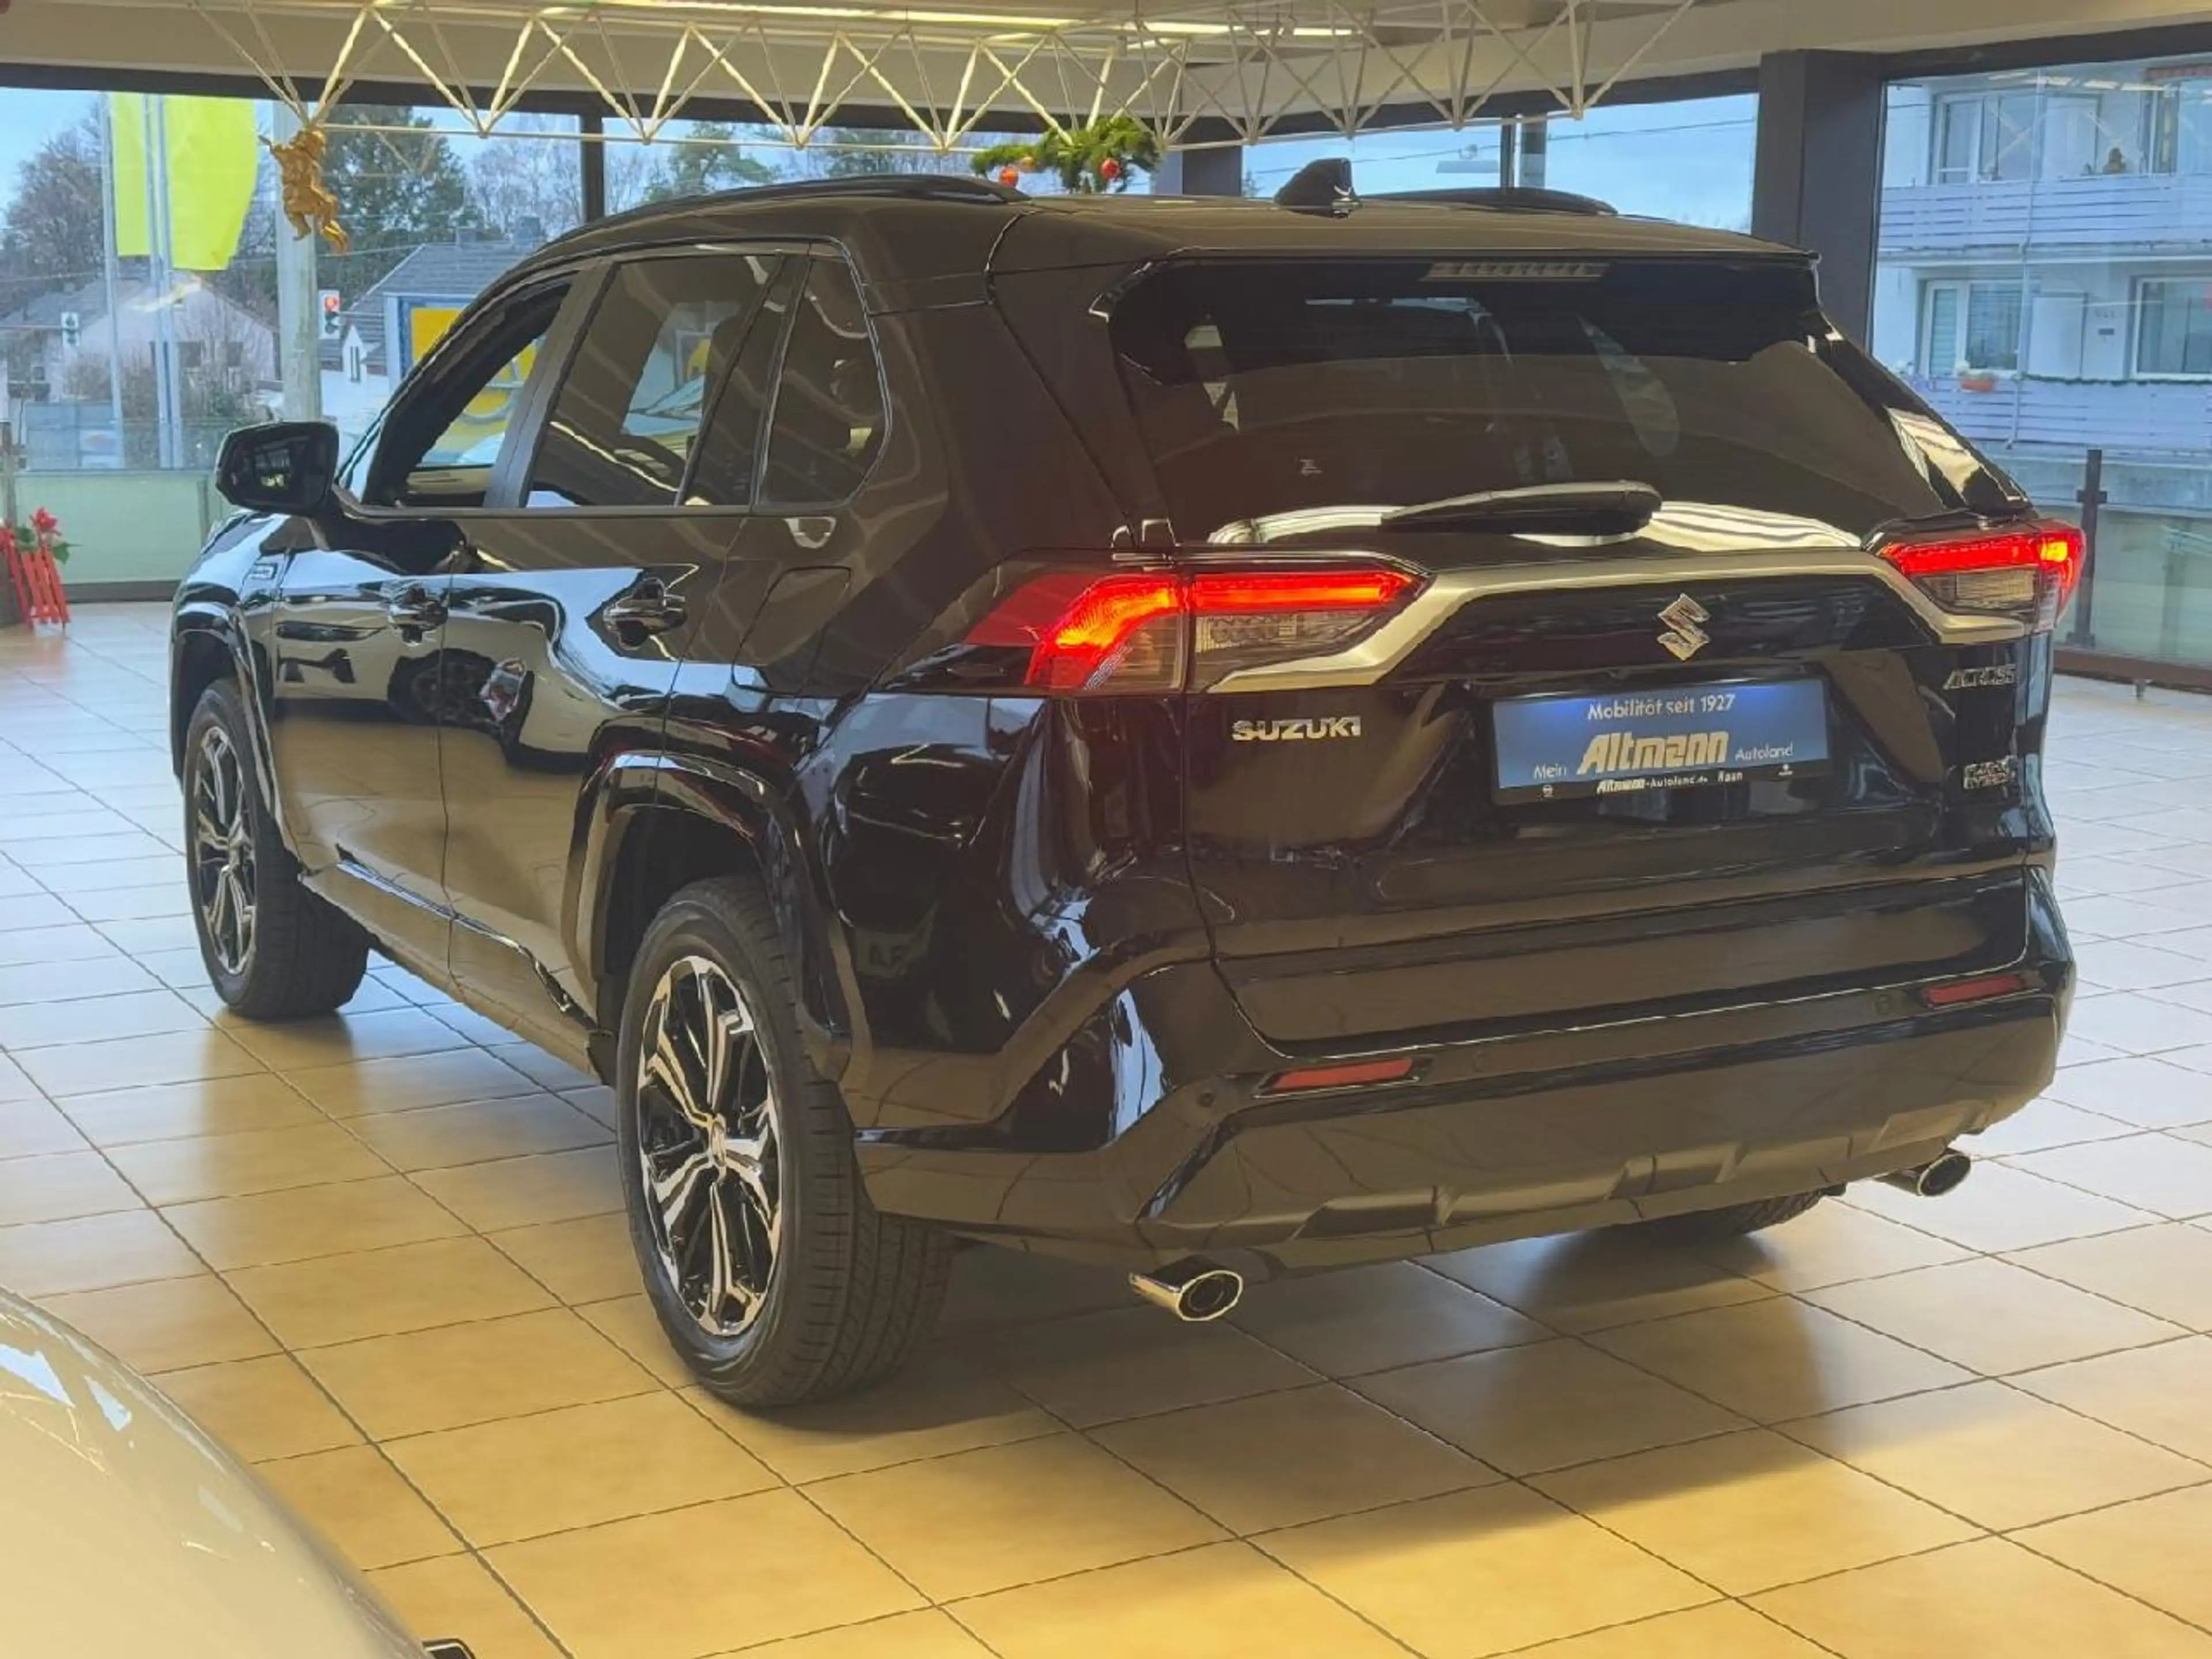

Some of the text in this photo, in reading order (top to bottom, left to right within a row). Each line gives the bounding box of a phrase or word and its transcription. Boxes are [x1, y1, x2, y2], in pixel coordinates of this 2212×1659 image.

[1943, 664, 2016, 690] ACROSS
[1588, 694, 1736, 720] Mobilität seit 1927
[1232, 715, 1361, 741] SUZUKI
[1533, 730, 1793, 780] Mein Altmann Autoland
